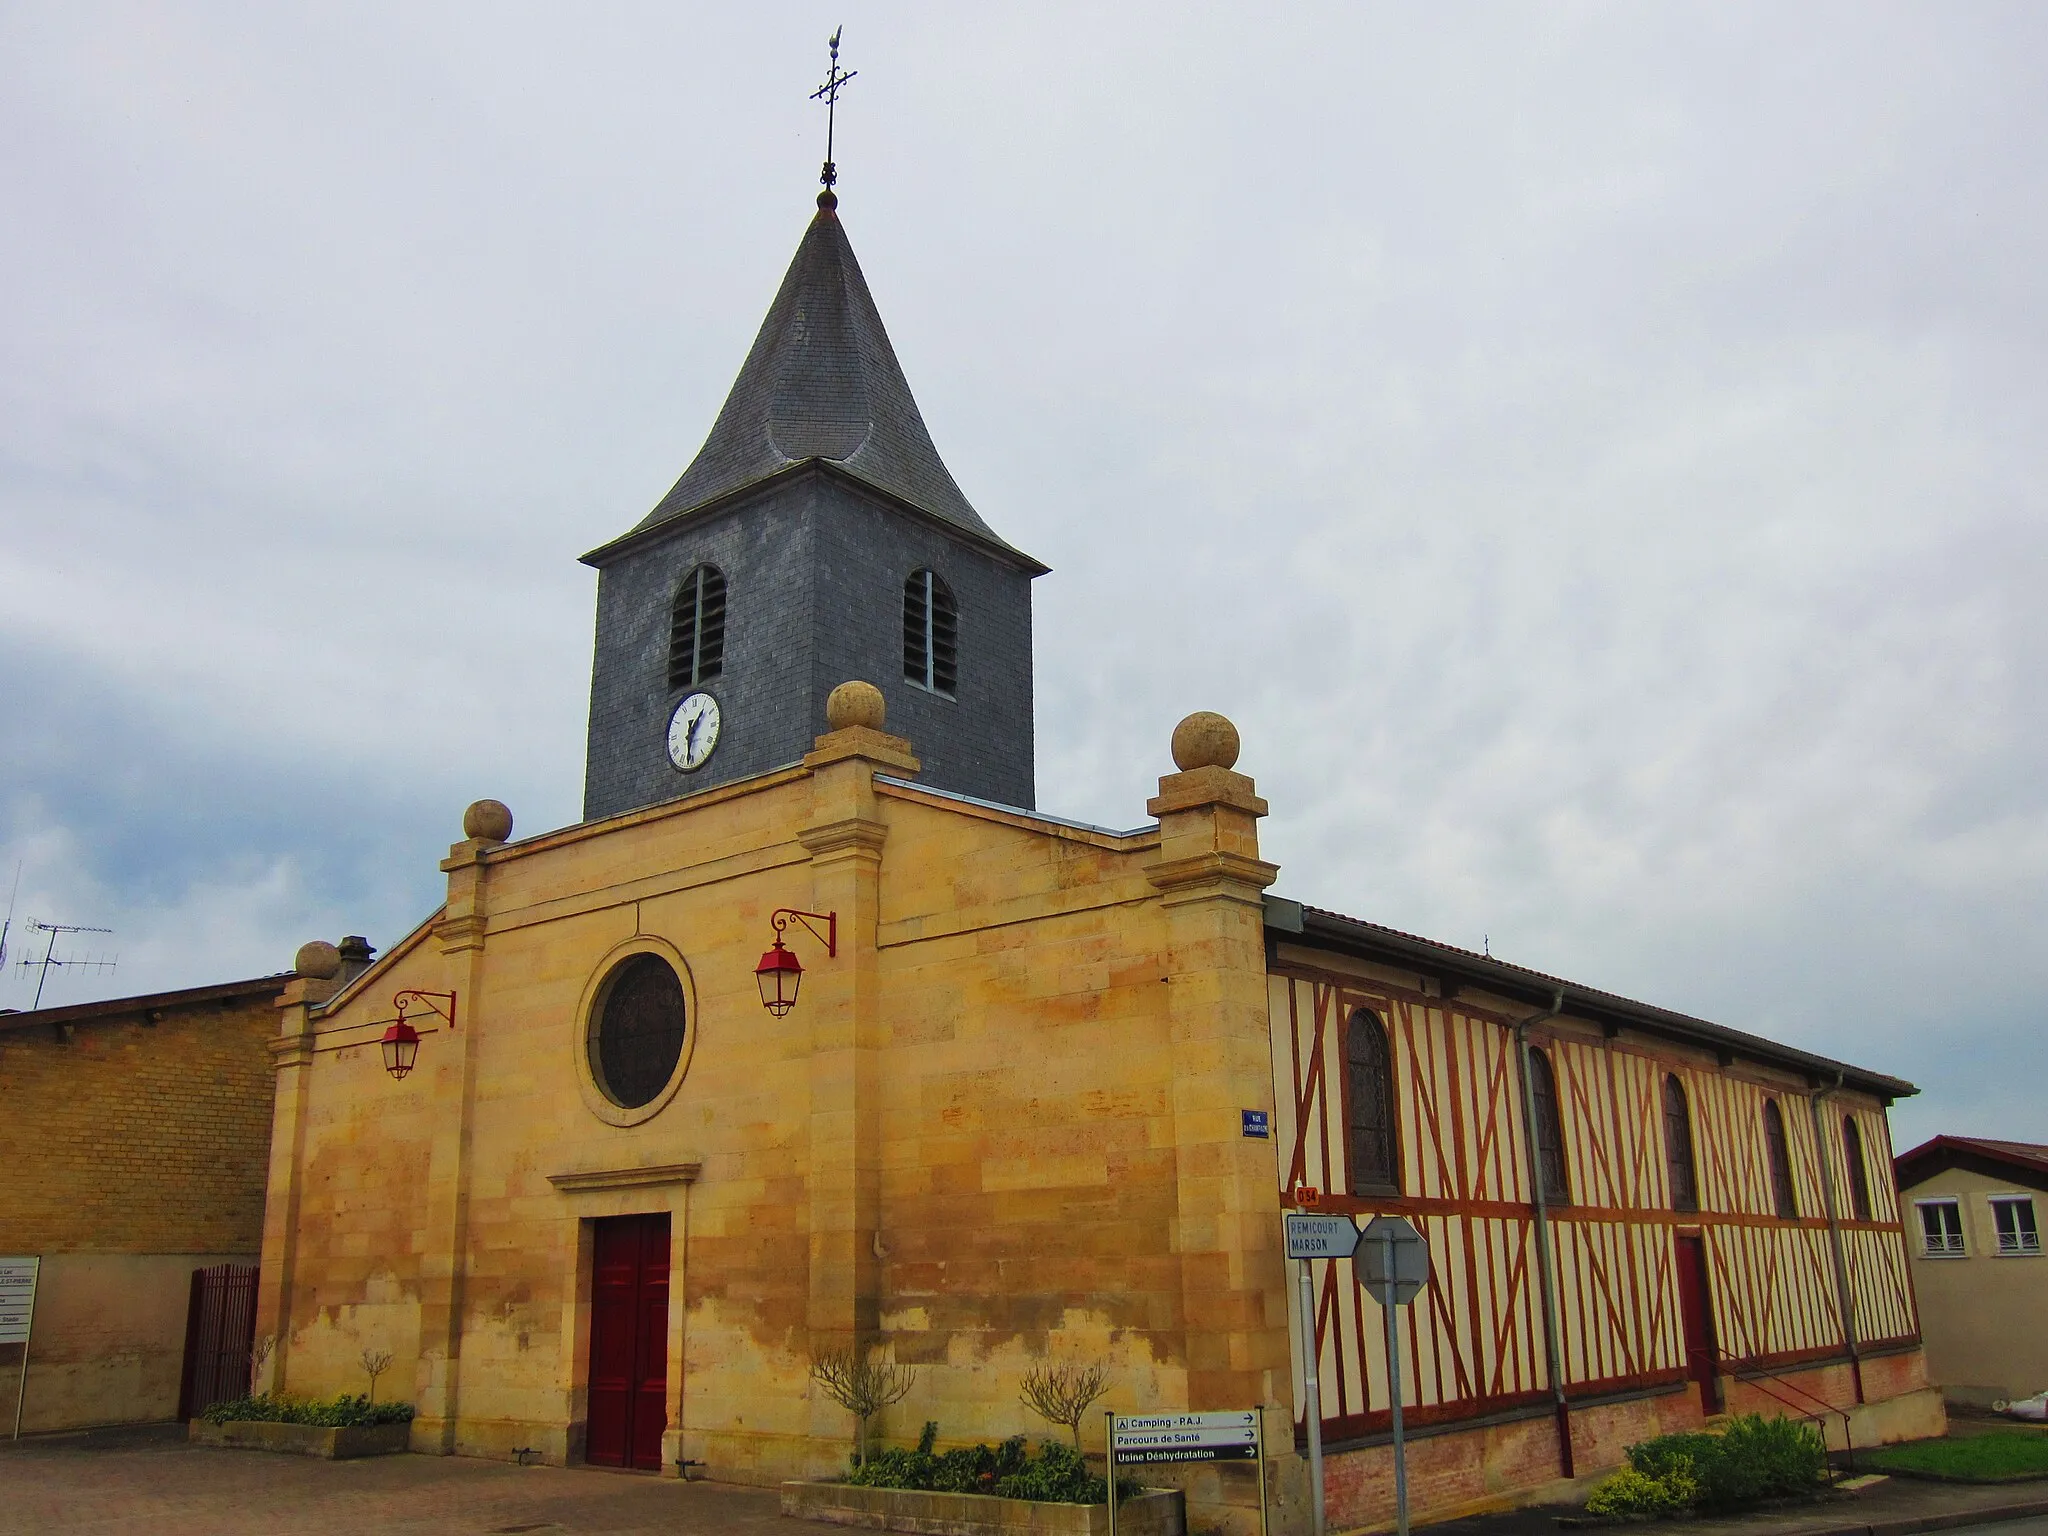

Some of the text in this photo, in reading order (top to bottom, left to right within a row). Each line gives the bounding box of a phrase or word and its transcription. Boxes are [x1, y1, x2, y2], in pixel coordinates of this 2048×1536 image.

[1306, 1190, 1316, 1202] 54
[1291, 1222, 1338, 1234] REMICOURT
[1292, 1239, 1328, 1251] MARSON
[1131, 1418, 1171, 1428] Camping
[1117, 1433, 1200, 1445] Parcours de Santé
[1118, 1449, 1215, 1462] Usine Déshydratation
